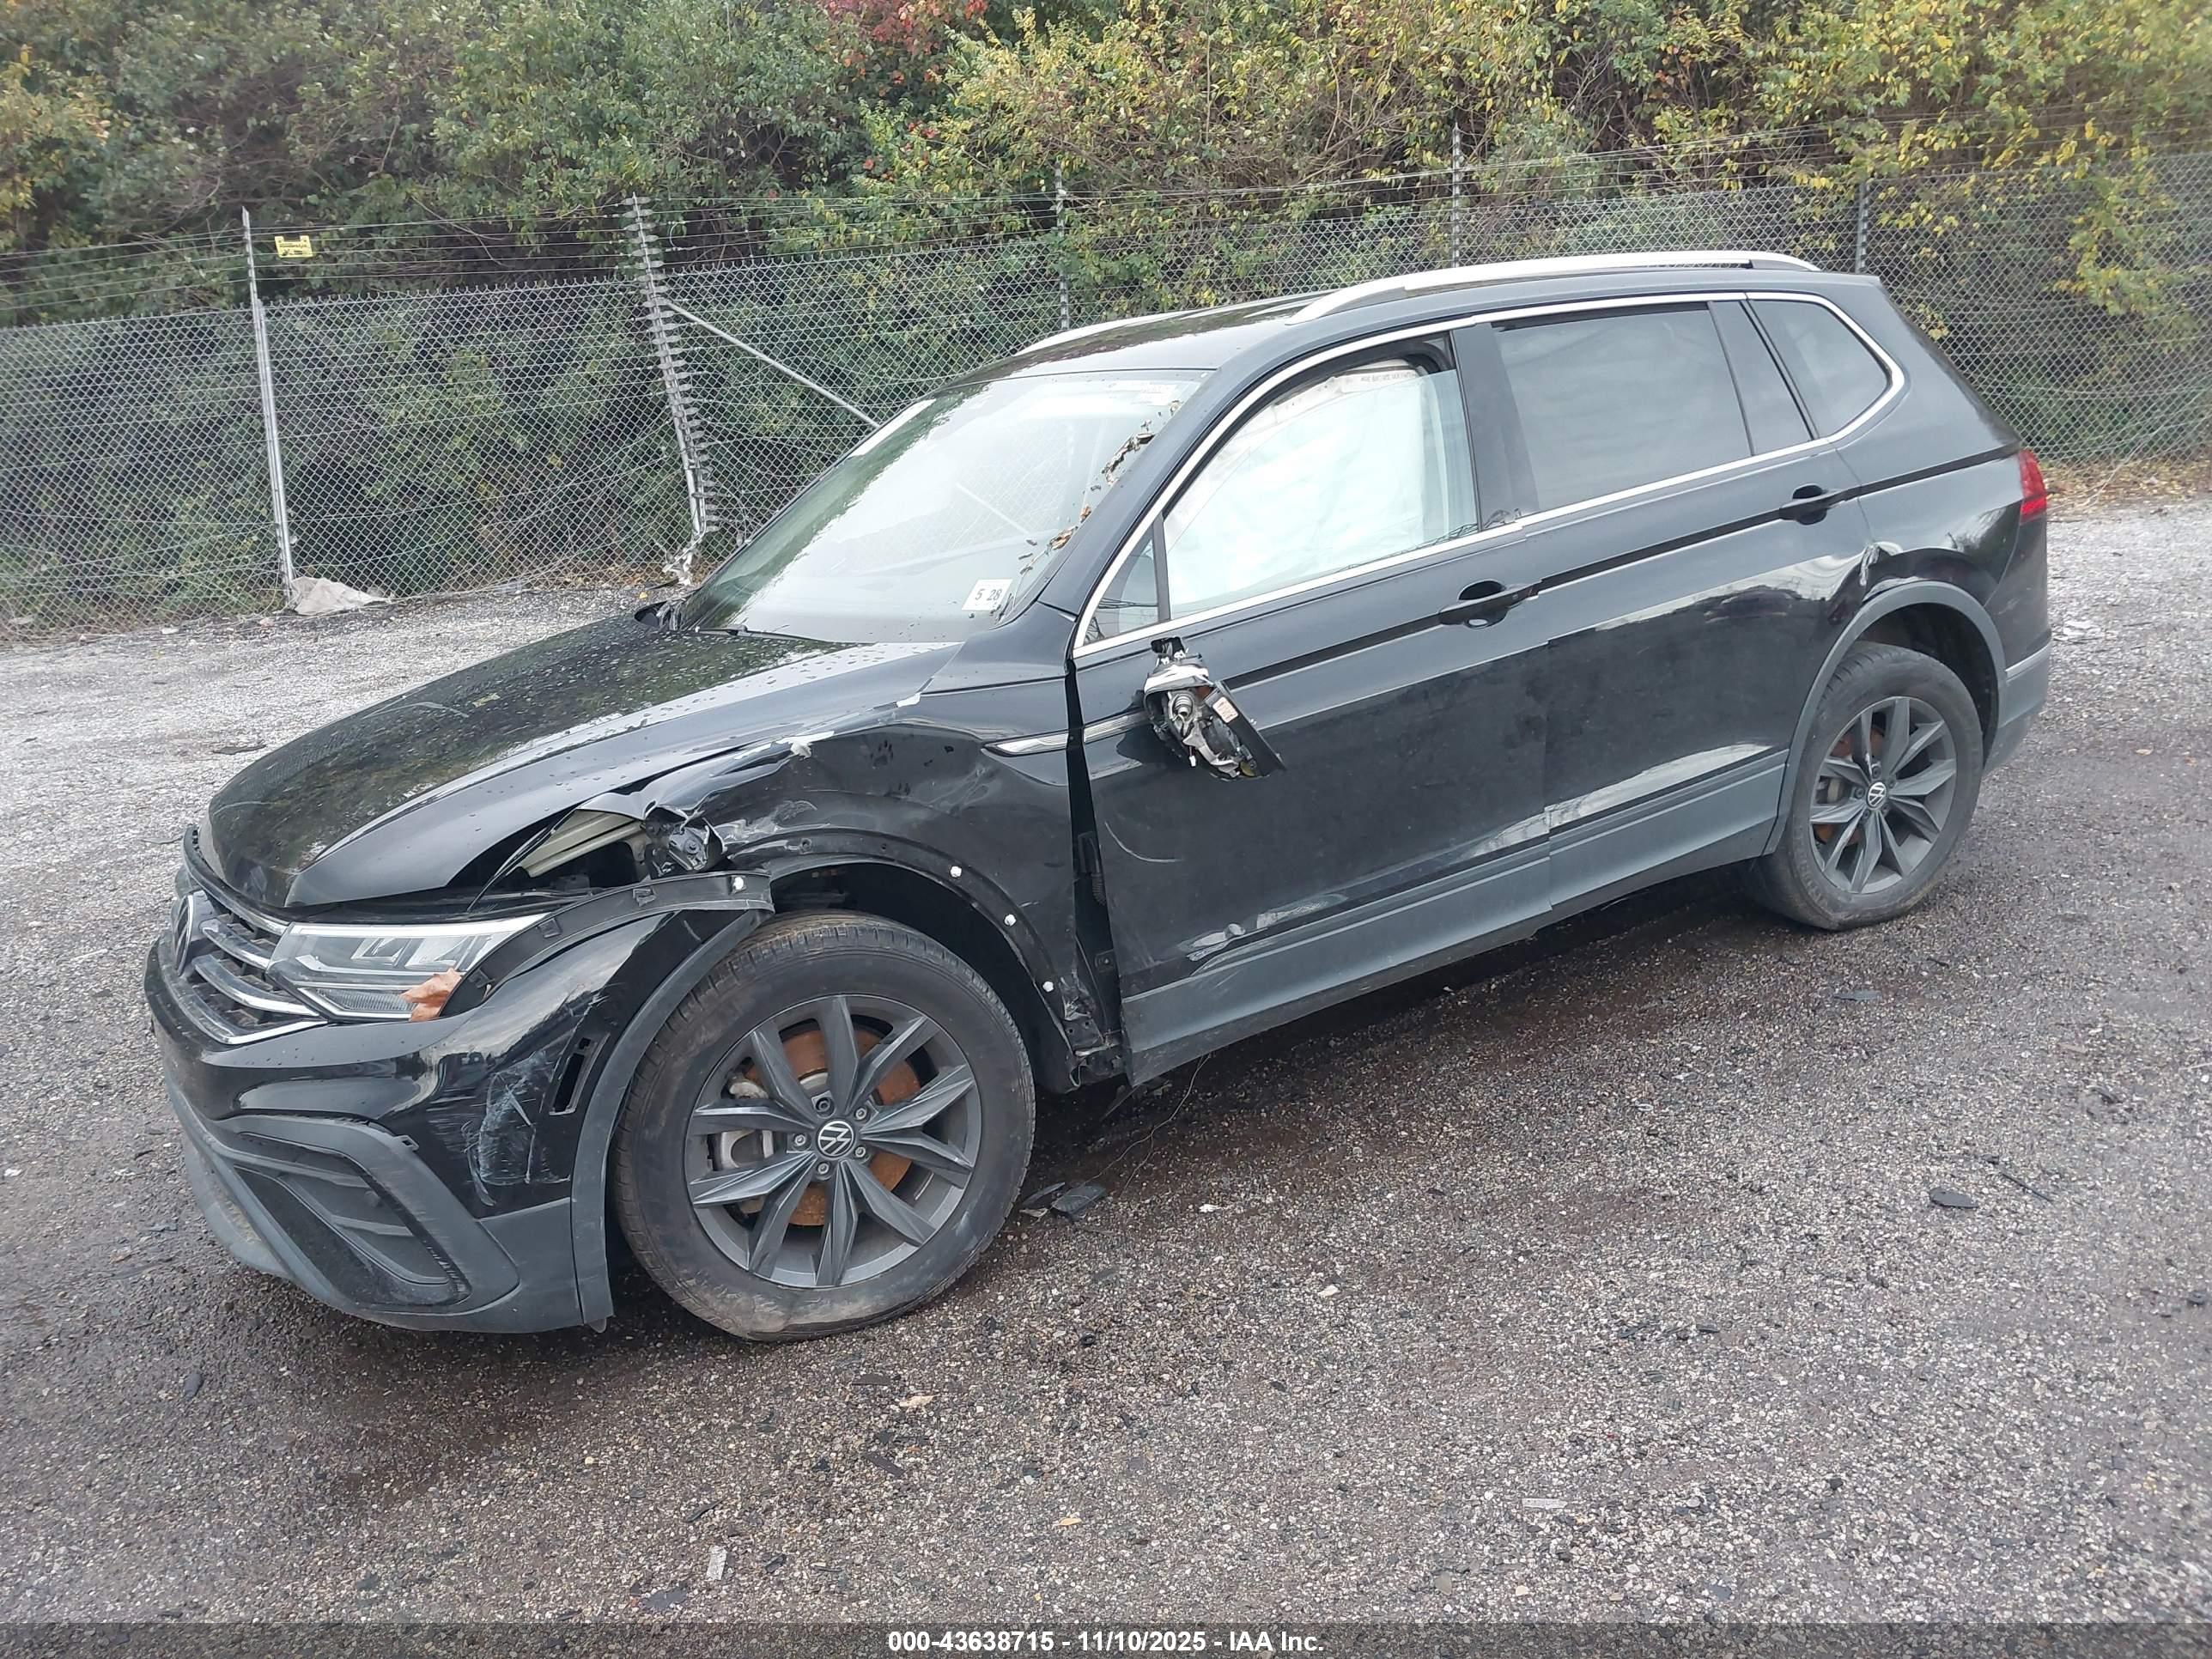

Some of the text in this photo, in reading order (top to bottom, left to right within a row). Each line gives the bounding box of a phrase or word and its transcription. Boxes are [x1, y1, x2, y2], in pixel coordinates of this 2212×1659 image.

[975, 588, 1002, 601] 5 28
[817, 1120, 854, 1157] VW
